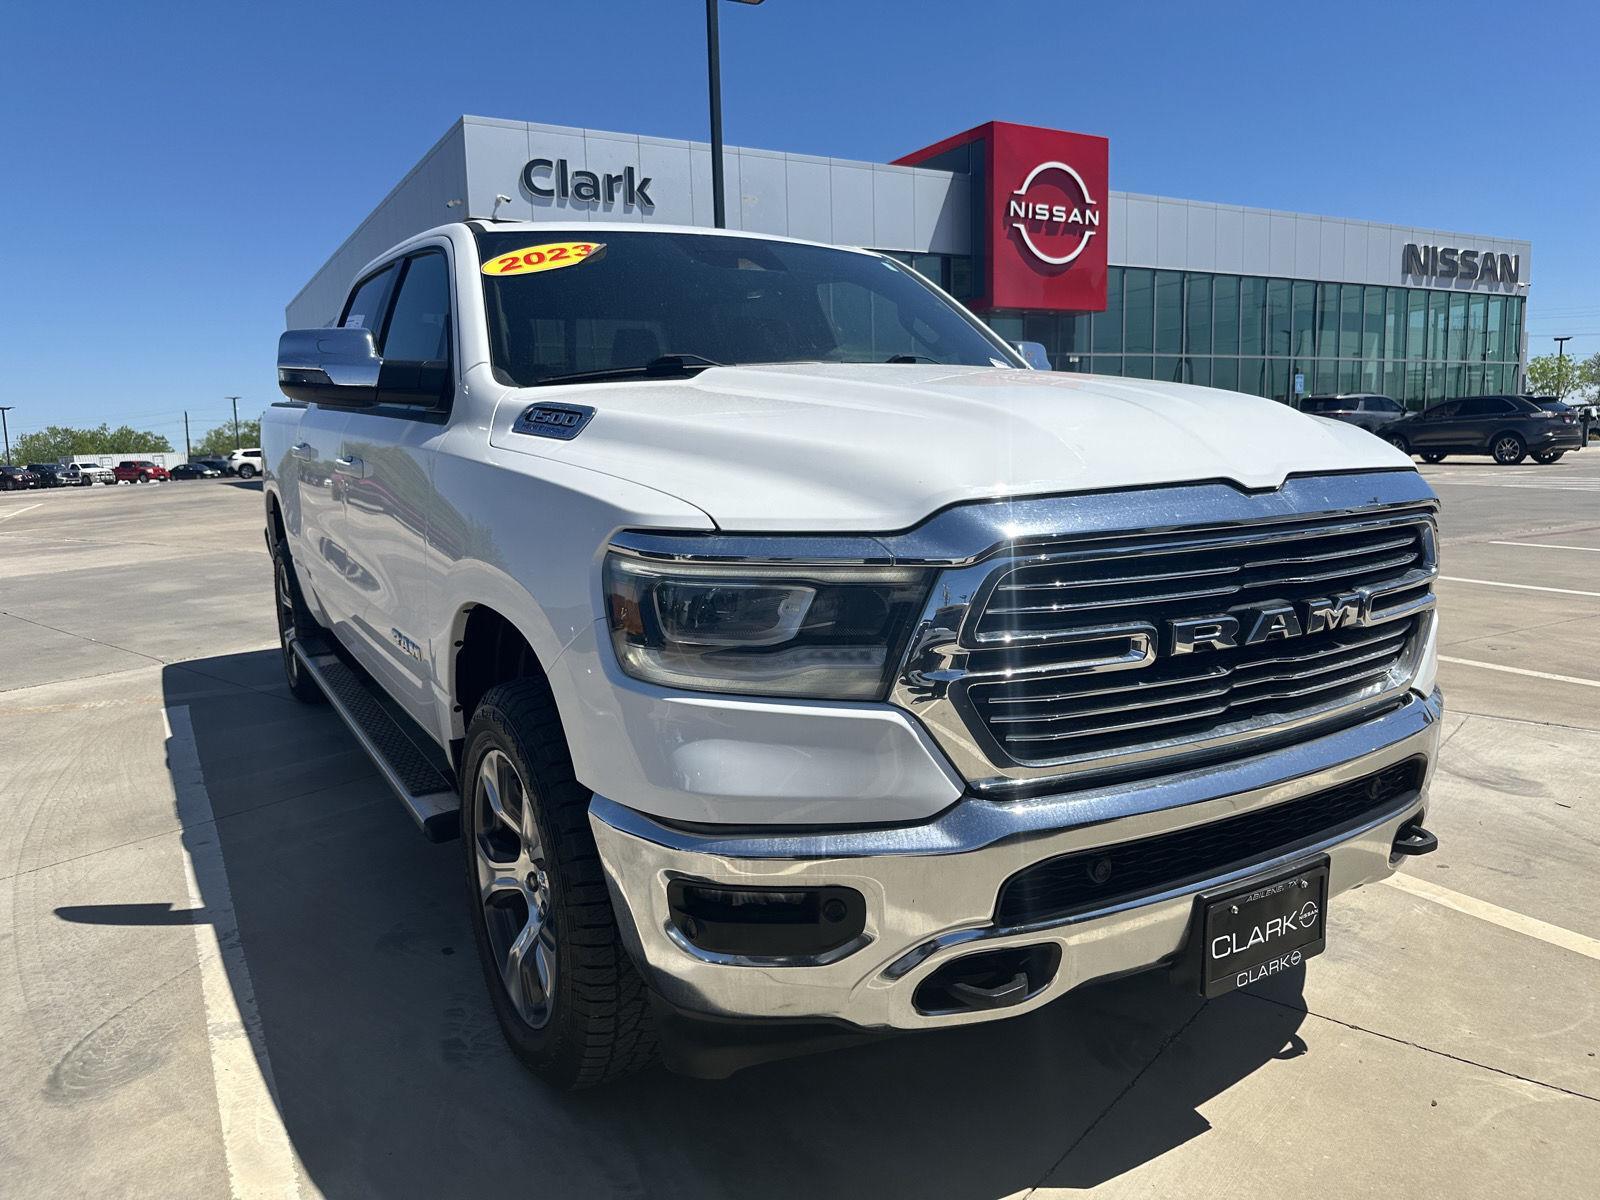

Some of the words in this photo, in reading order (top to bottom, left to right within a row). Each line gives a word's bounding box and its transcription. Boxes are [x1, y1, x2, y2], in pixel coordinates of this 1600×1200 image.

[519, 158, 655, 209] Clark
[1009, 200, 1099, 226] NISSAN
[498, 244, 592, 272] 2023
[1402, 243, 1520, 284] NISSAN
[527, 408, 581, 427] 1500
[1169, 592, 1360, 656] RAM
[1211, 910, 1298, 960] CLARK
[1236, 954, 1290, 988] CLARK
